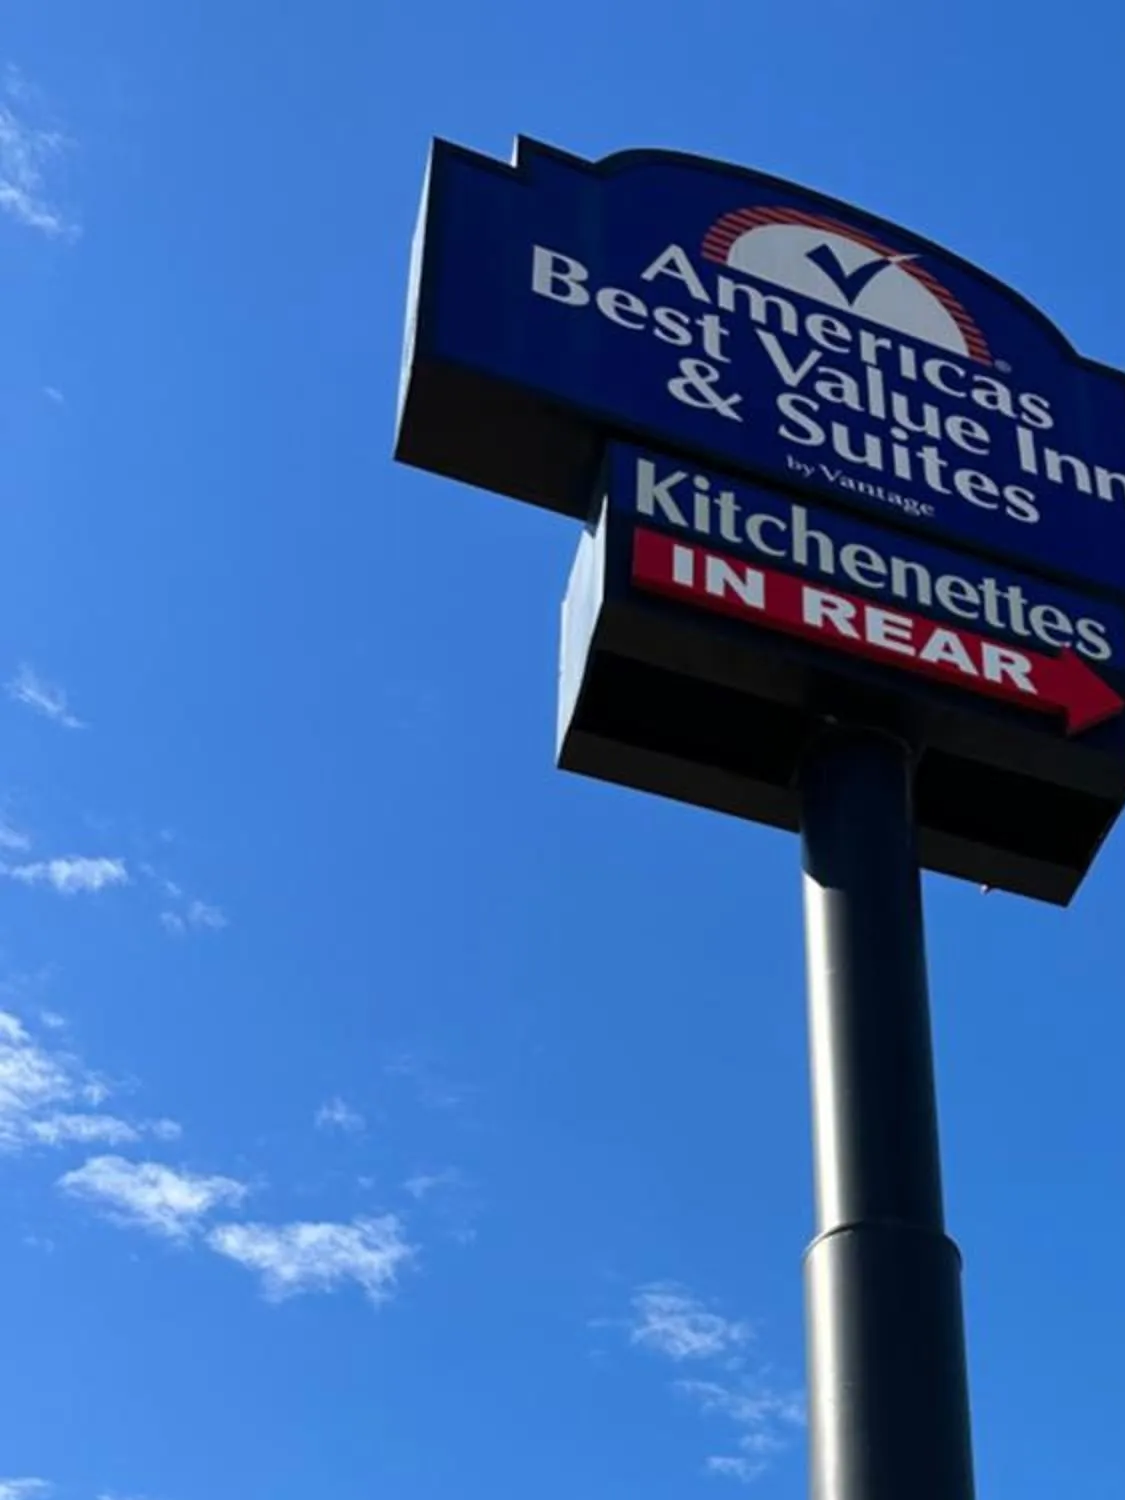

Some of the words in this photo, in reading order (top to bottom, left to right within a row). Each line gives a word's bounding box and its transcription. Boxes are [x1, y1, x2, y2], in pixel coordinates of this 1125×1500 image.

[530, 244, 732, 363] Best
[754, 329, 990, 457] Value
[640, 243, 1055, 430] Americas
[666, 357, 743, 422] &
[778, 392, 1041, 524] Suites
[786, 453, 815, 478] by
[817, 463, 936, 517] Vantage
[635, 457, 1113, 664] Kitchenettes
[671, 545, 766, 609] IN
[802, 586, 1039, 696] REAR
